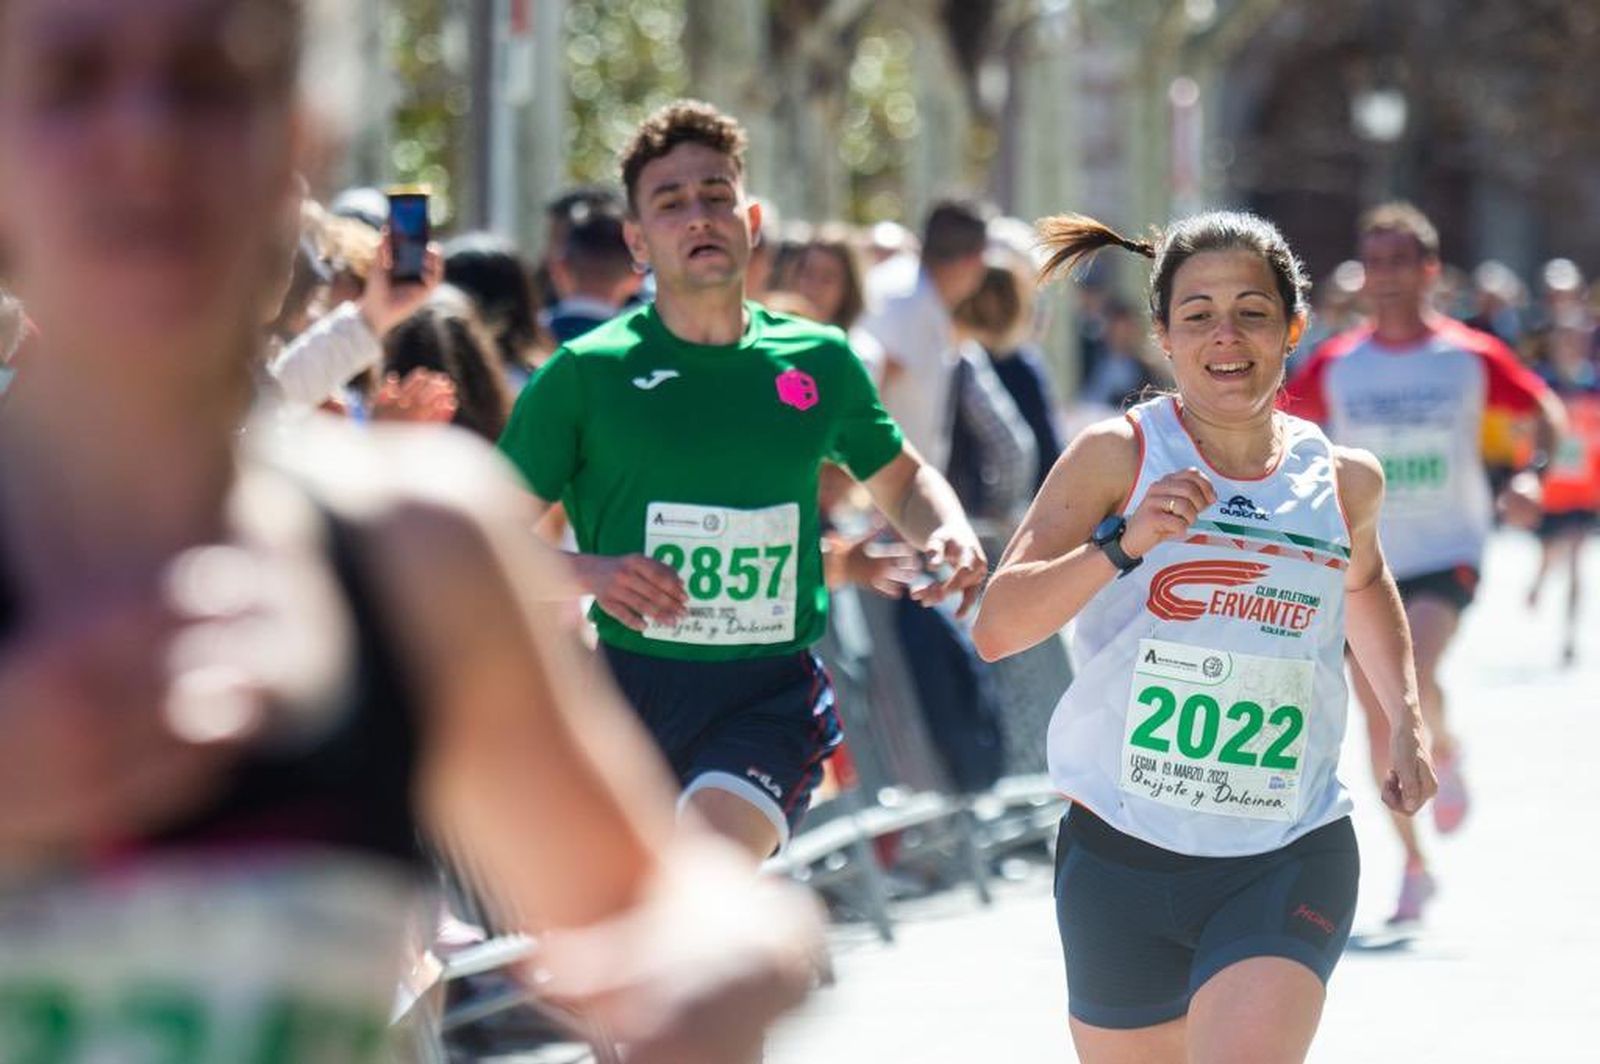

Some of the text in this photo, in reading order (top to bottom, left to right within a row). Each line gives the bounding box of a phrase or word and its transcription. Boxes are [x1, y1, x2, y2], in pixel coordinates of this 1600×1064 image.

[1255, 585, 1278, 598] CLUB
[1130, 685, 1304, 770] 2022
[1131, 754, 1157, 773] LEGUA
[1130, 768, 1286, 809] Quijote y Dulcinea
